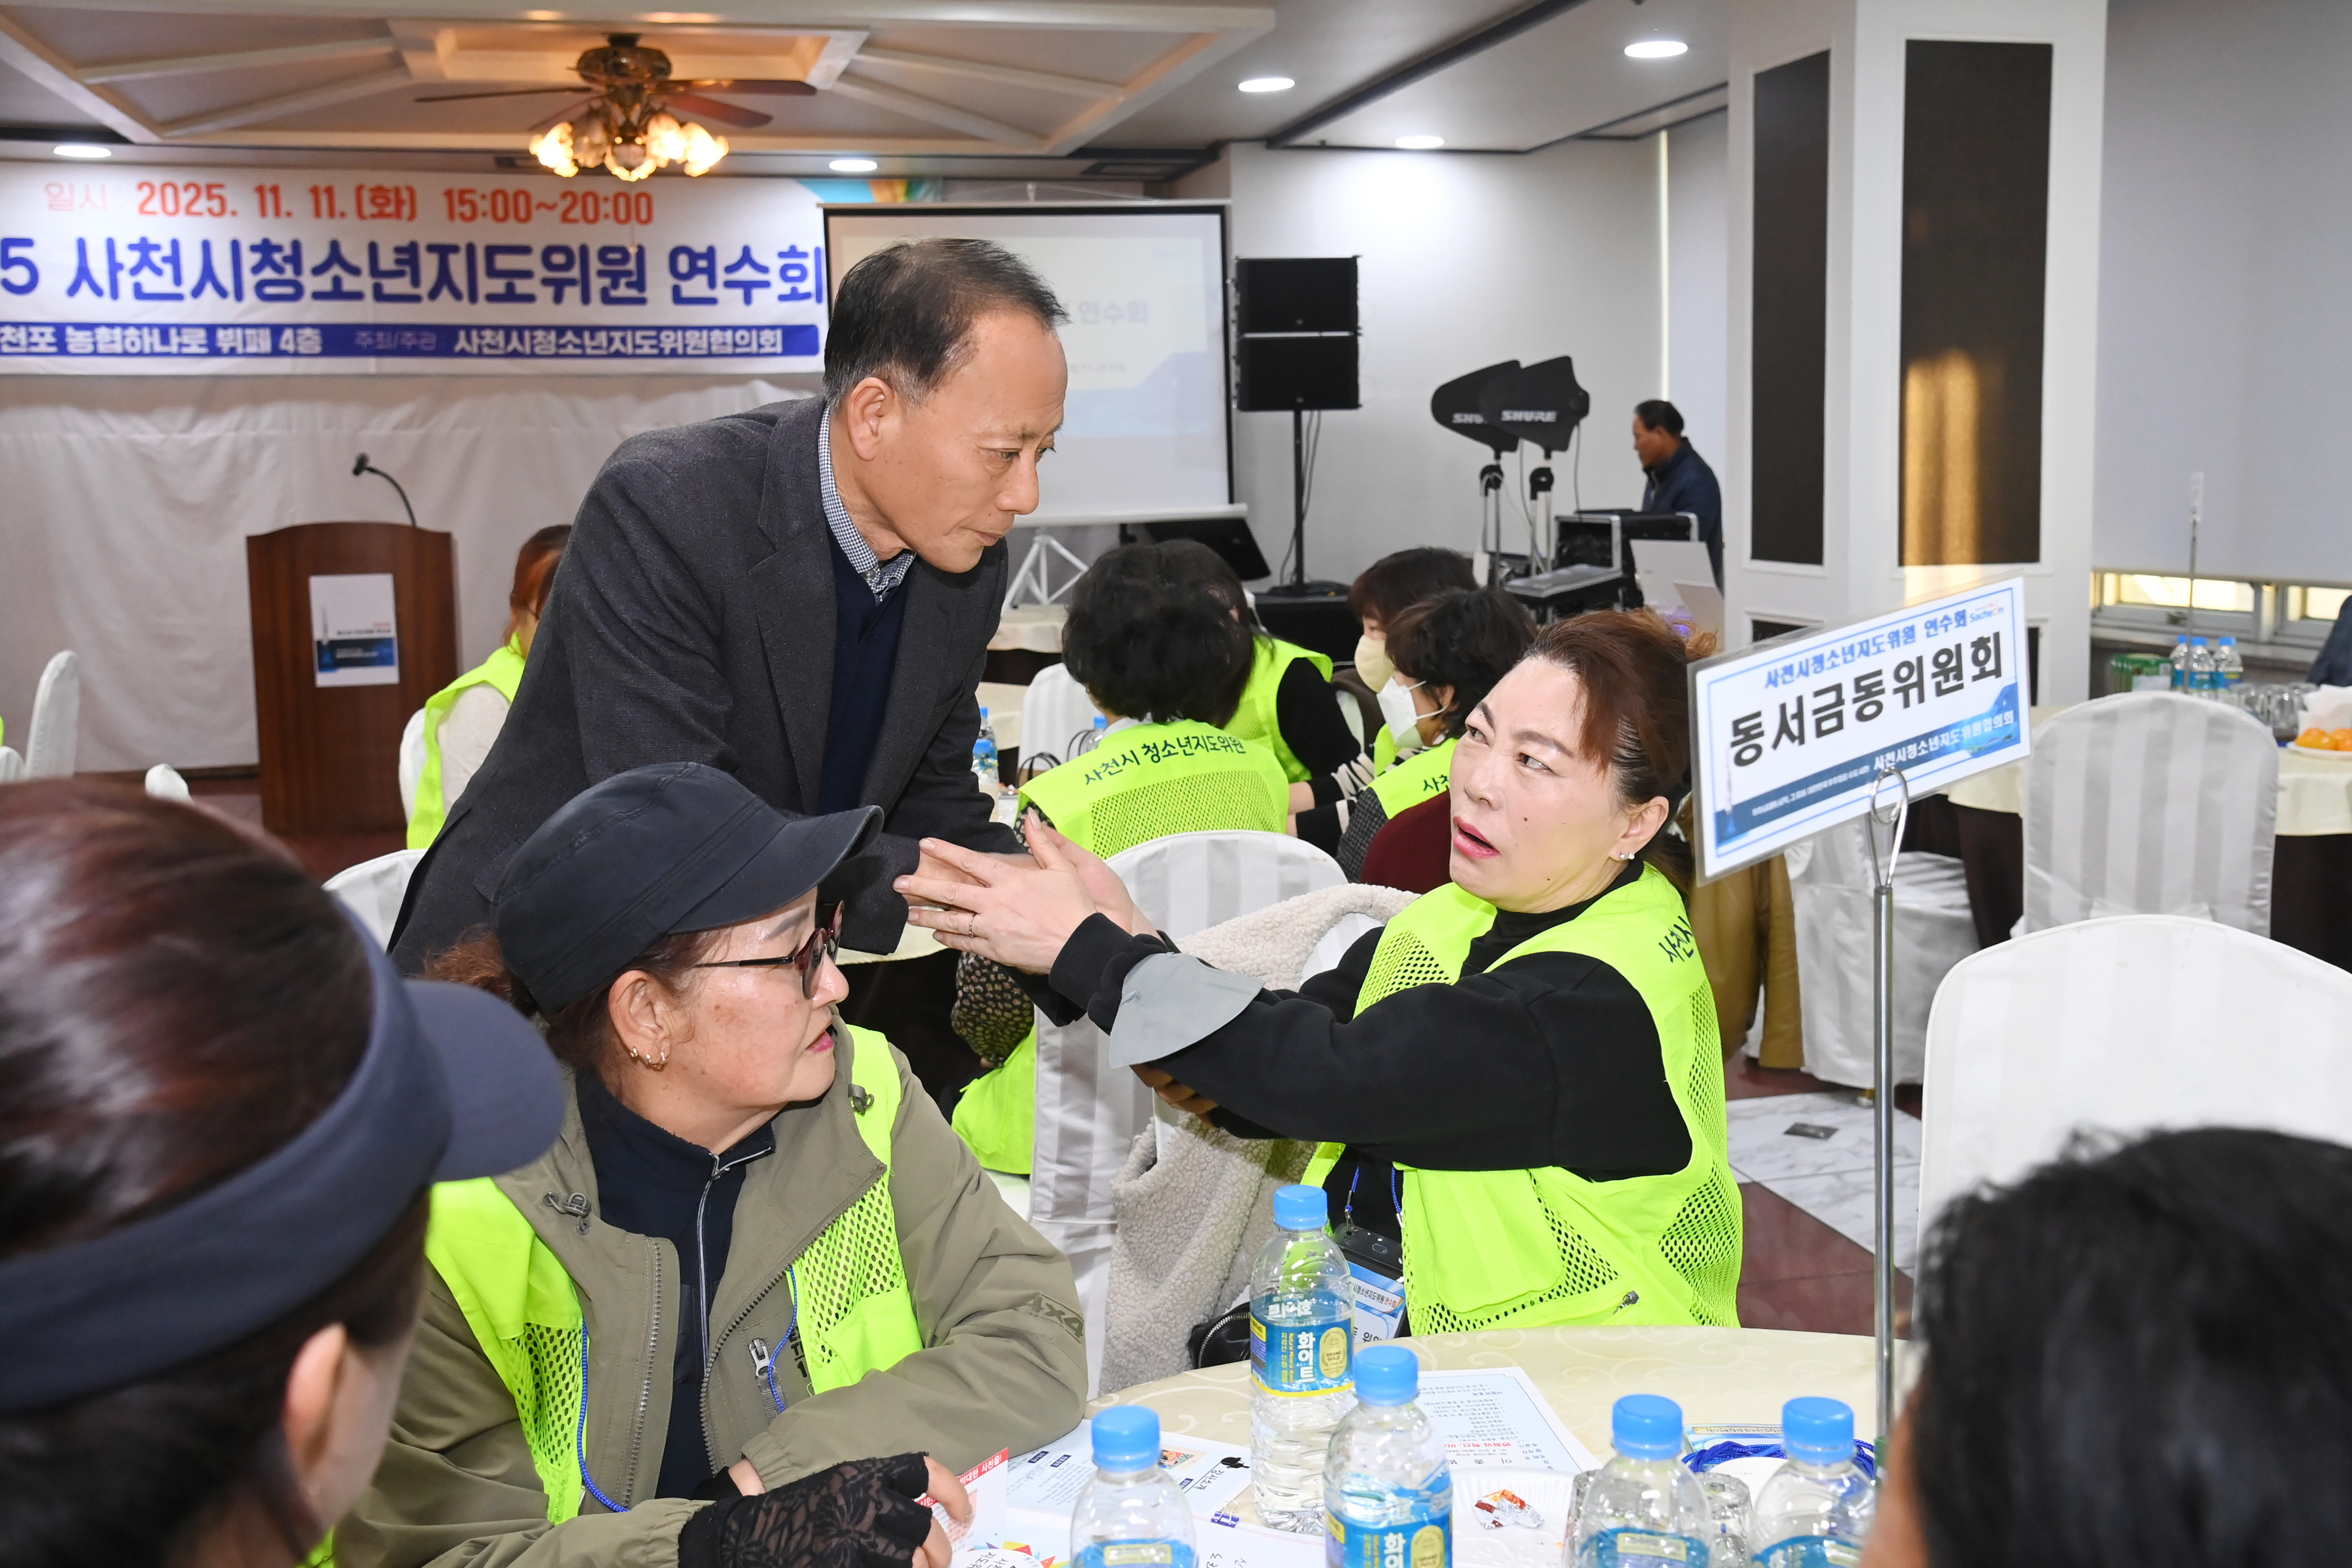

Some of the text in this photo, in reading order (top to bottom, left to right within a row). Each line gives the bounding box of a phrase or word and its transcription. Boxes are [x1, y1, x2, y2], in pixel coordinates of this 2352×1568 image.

[45, 181, 107, 213] 일시
[136, 181, 239, 217] 2025.
[254, 184, 293, 219] 11.
[443, 188, 654, 225] 15:00~20:00
[66, 236, 648, 306] 사천시청소년지도위원
[668, 244, 823, 306] 연수회
[1078, 300, 1149, 324] 연수회
[65, 326, 209, 354] 농협하나로
[279, 326, 323, 355] 4층
[454, 327, 783, 355] 사천시청소년지도위원협의회
[1500, 409, 1557, 422] SHURE
[1765, 608, 1967, 689] 사천시청소년지도위원 연수회
[1730, 631, 2002, 767] 동서금동위원회
[1352, 1282, 1385, 1304] 시청소년지도위원
[1298, 1331, 1316, 1384] 화이트
